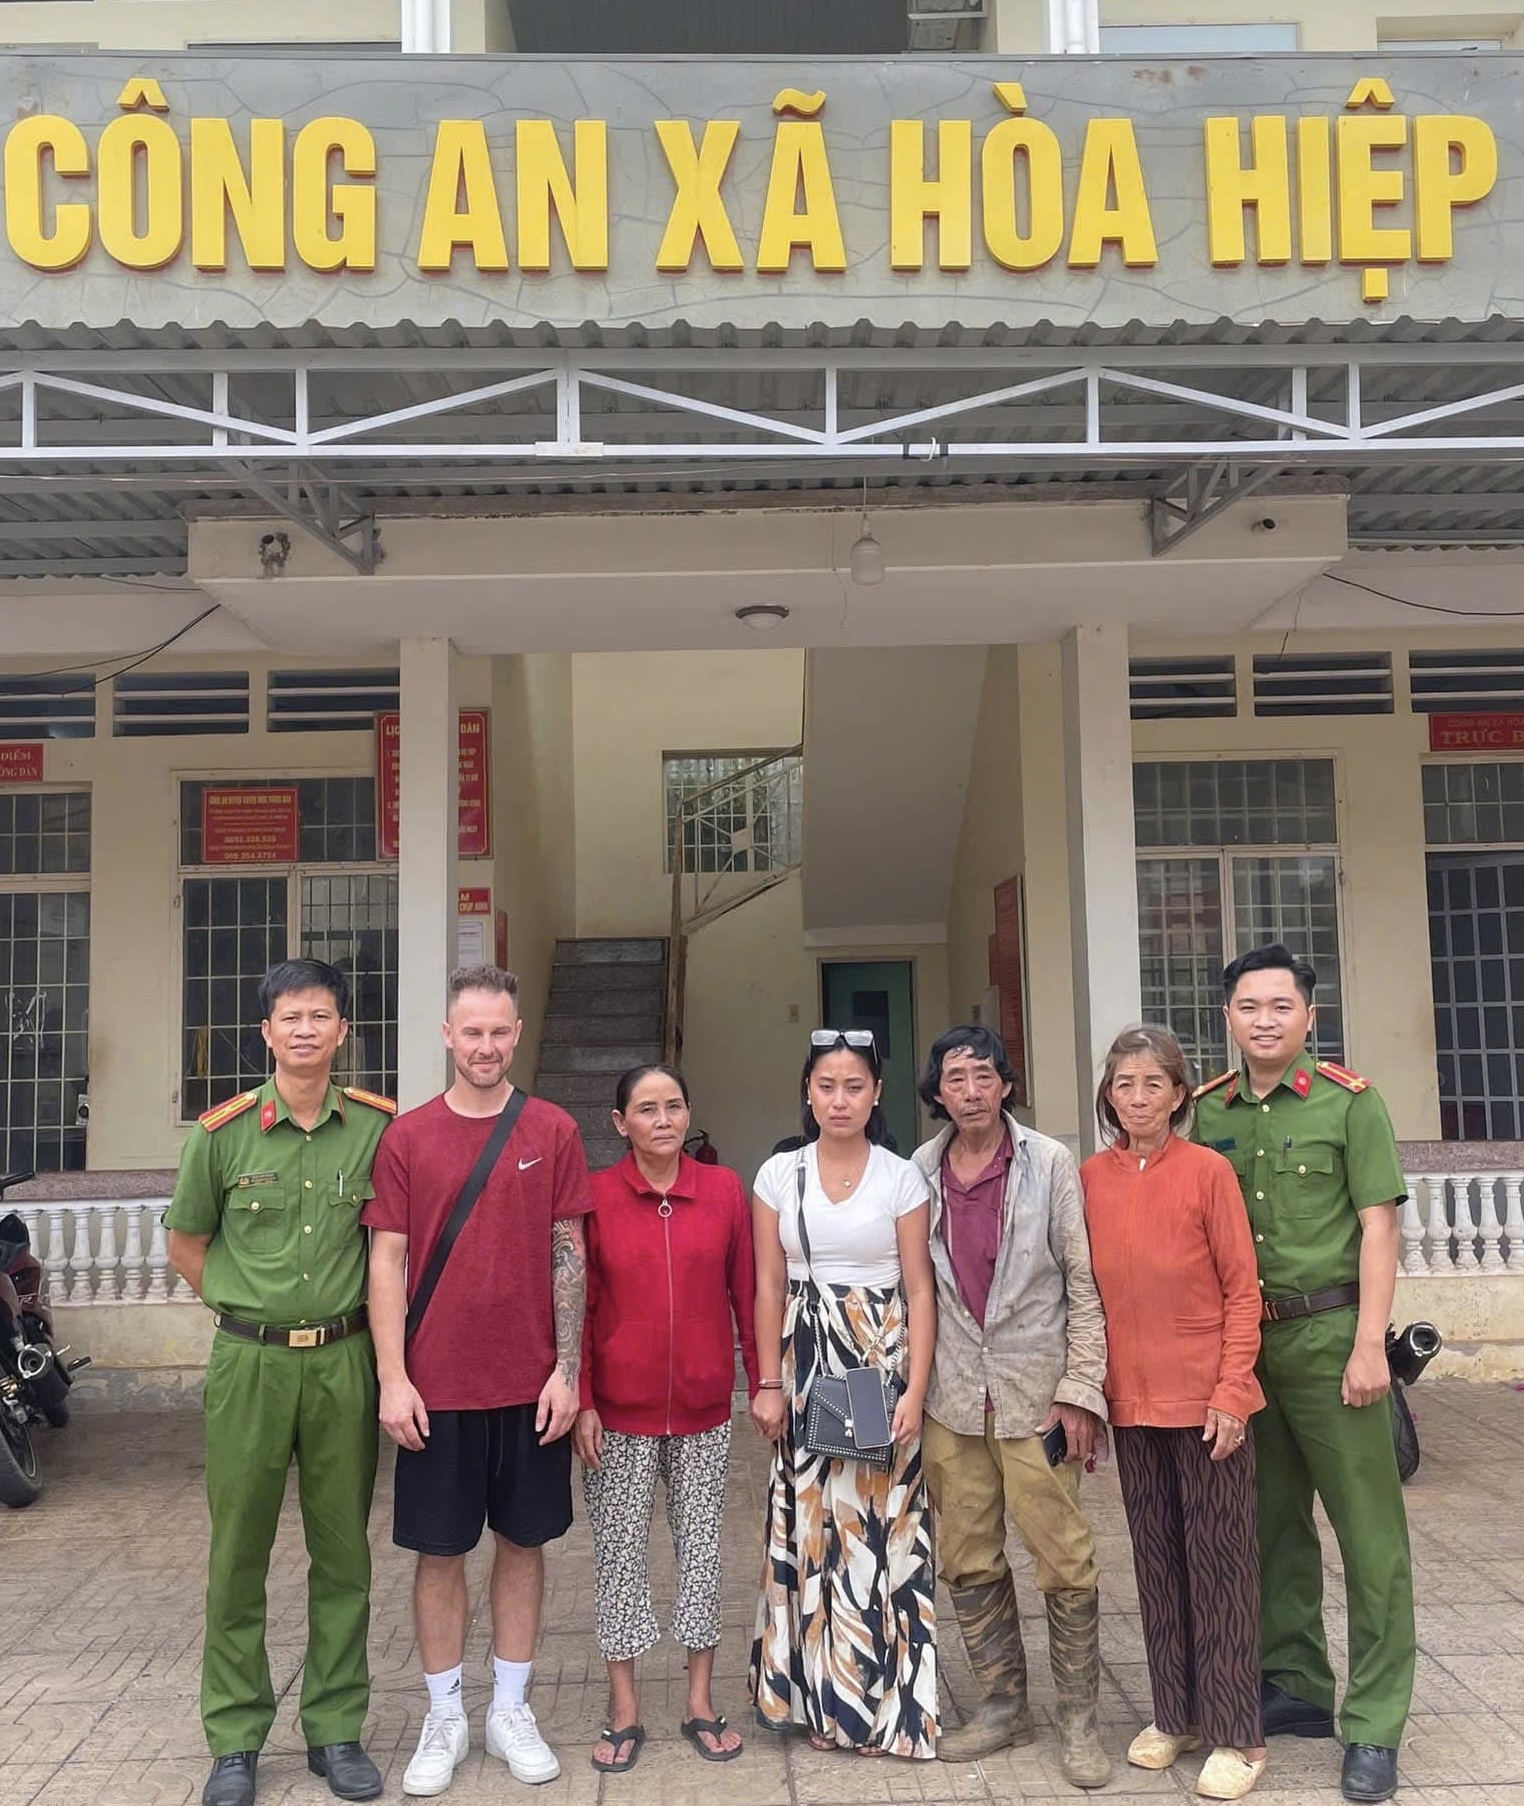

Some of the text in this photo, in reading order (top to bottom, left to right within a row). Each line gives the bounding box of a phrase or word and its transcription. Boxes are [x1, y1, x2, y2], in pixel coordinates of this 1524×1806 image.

[4, 77, 1499, 302] CÔNG AN XÃ HÒA HIỆP
